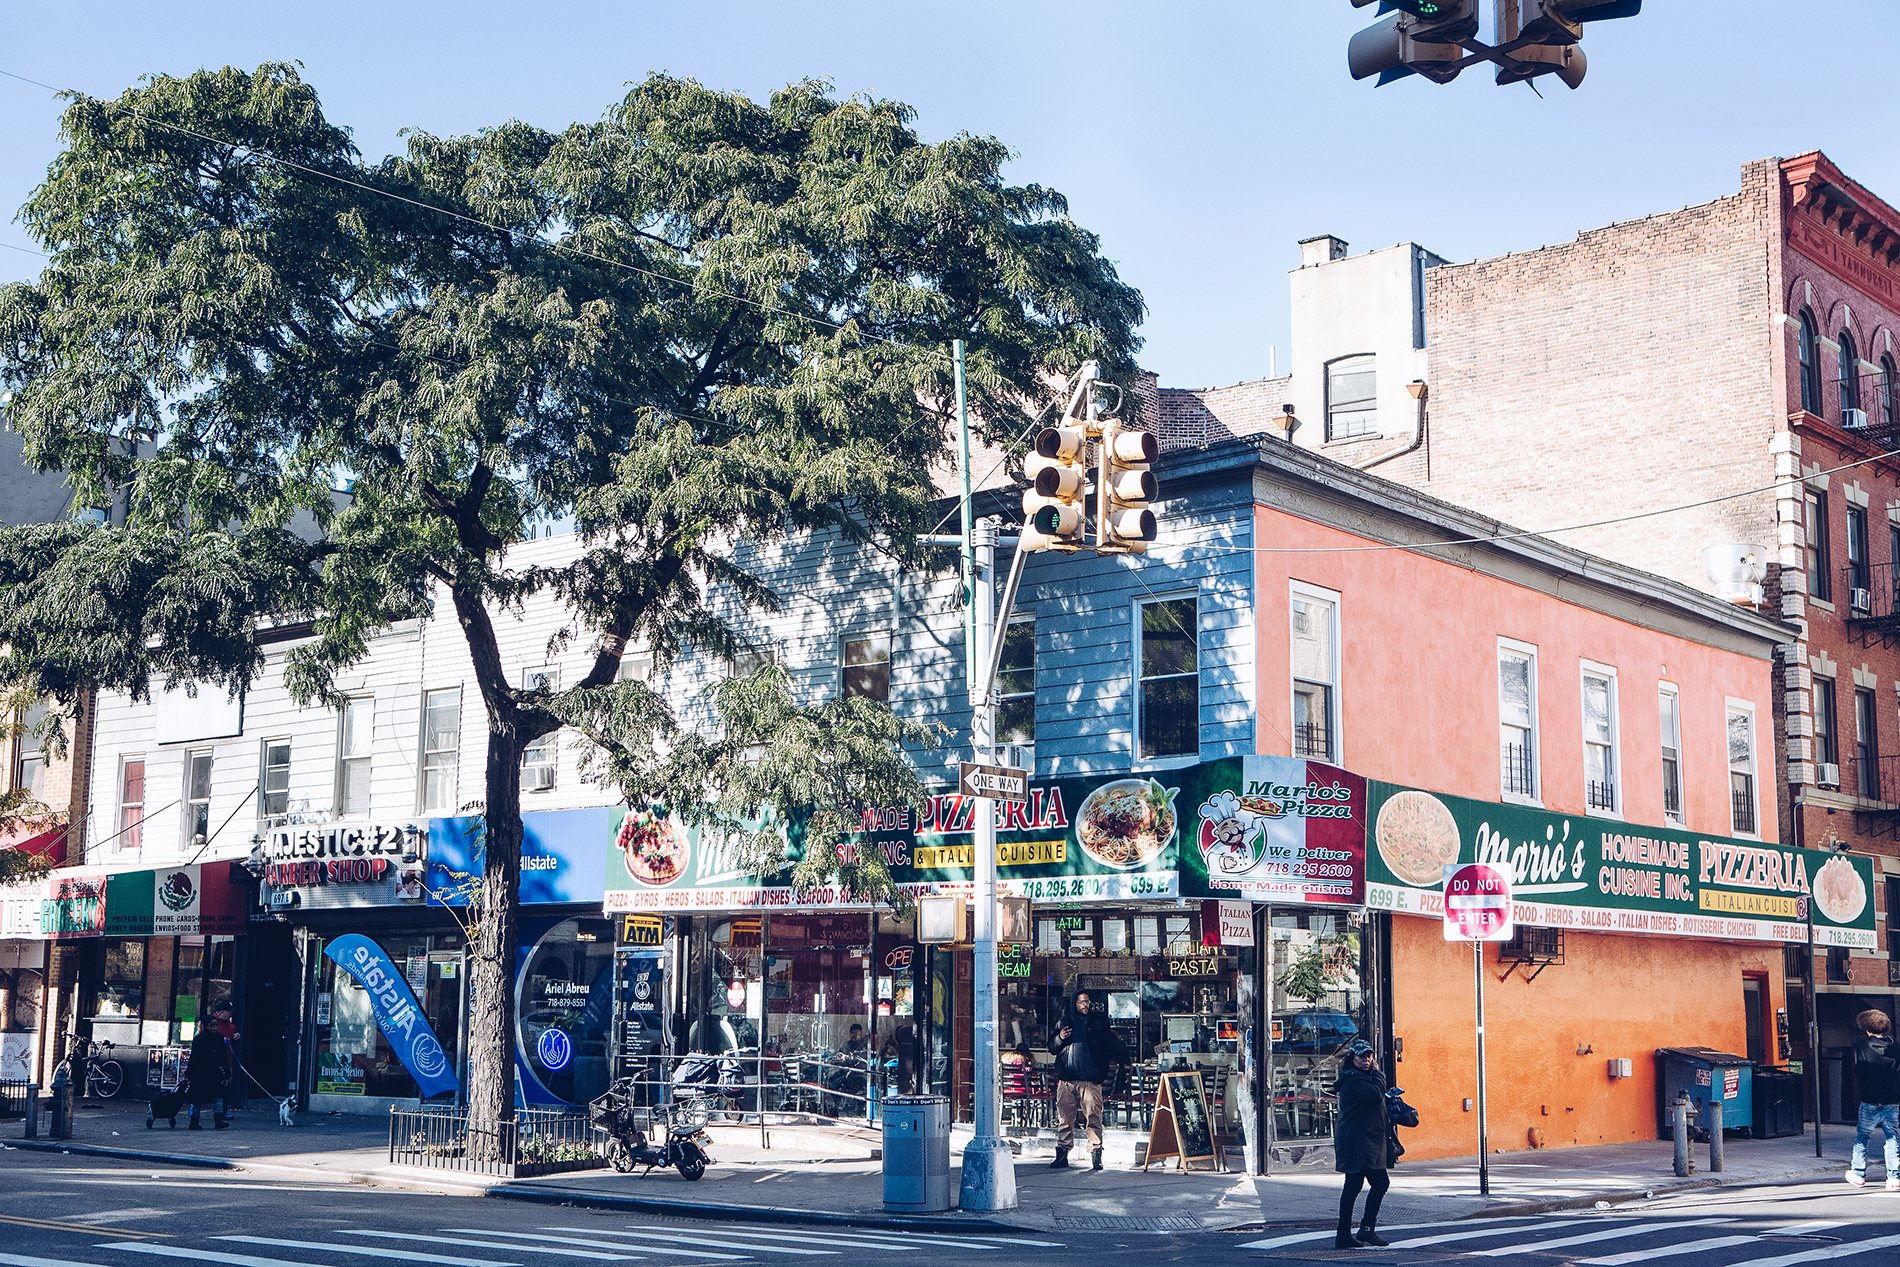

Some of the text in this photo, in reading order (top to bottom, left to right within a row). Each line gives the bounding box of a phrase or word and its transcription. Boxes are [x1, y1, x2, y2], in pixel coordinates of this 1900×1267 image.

[973, 774, 1019, 791] ONE WAY
[1246, 780, 1351, 800] Mario's
[1279, 800, 1351, 818] Pizza
[917, 855, 924, 864] &
[1000, 844, 1063, 862] CUISINE
[1269, 847, 1352, 860] We Deliver
[1475, 819, 1586, 885] Mario's
[1601, 832, 1690, 869] HOMEMADE
[265, 858, 387, 886] BARBER SHOP
[1266, 862, 1352, 877] 718 295 2600
[1699, 840, 1810, 894] PIZZERIA
[1023, 878, 1099, 898] 718.295.2600
[1131, 877, 1154, 894] 699
[1157, 876, 1169, 893] E.
[1209, 880, 1352, 895] Home Made Cuisine
[1454, 879, 1501, 892] DO NOT
[1599, 865, 1694, 901] CUISINE INC.
[273, 892, 290, 903] 697 E
[608, 893, 628, 907] PIZZA
[634, 892, 659, 907] GYROS
[665, 891, 689, 906] HEROS
[695, 890, 724, 906] SALADS
[729, 889, 759, 906] ITALIAN
[761, 888, 790, 906] DISHES
[795, 888, 834, 905] SEAFOOD
[1704, 893, 1797, 914] & ITALIAN CUISI
[155, 915, 174, 923] PHONE
[176, 915, 195, 923] CARDS
[1220, 905, 1251, 918] ITALIAN
[1370, 888, 1393, 907] 699
[1397, 891, 1408, 908] E.
[1420, 894, 1444, 912] PIZZ
[1545, 906, 1573, 925] HEROS
[1581, 909, 1612, 928] SALADS
[1618, 912, 1648, 929] ITALIAN
[1650, 916, 1677, 932] DISHES
[1683, 917, 1724, 935] ROTISSERIE
[1727, 922, 1757, 937] CHICKEN
[1772, 924, 1789, 939] FREE
[1790, 925, 1821, 941] DELIVRY
[1828, 930, 1875, 946] 718.295.2600
[1458, 912, 1497, 926] ENTER
[106, 924, 127, 932] MONEY
[177, 924, 191, 932] FOOD
[1059, 917, 1081, 929] ATM
[1221, 922, 1250, 938] PIZZA
[626, 926, 659, 943] ATM
[885, 950, 914, 967] OPE
[997, 962, 1031, 977] REAM
[1170, 960, 1218, 975] PASTA
[545, 982, 590, 994] Ariel Abreu
[881, 979, 890, 992] A
[547, 998, 586, 1007] 718-879-8551
[630, 1002, 654, 1011] Allstate
